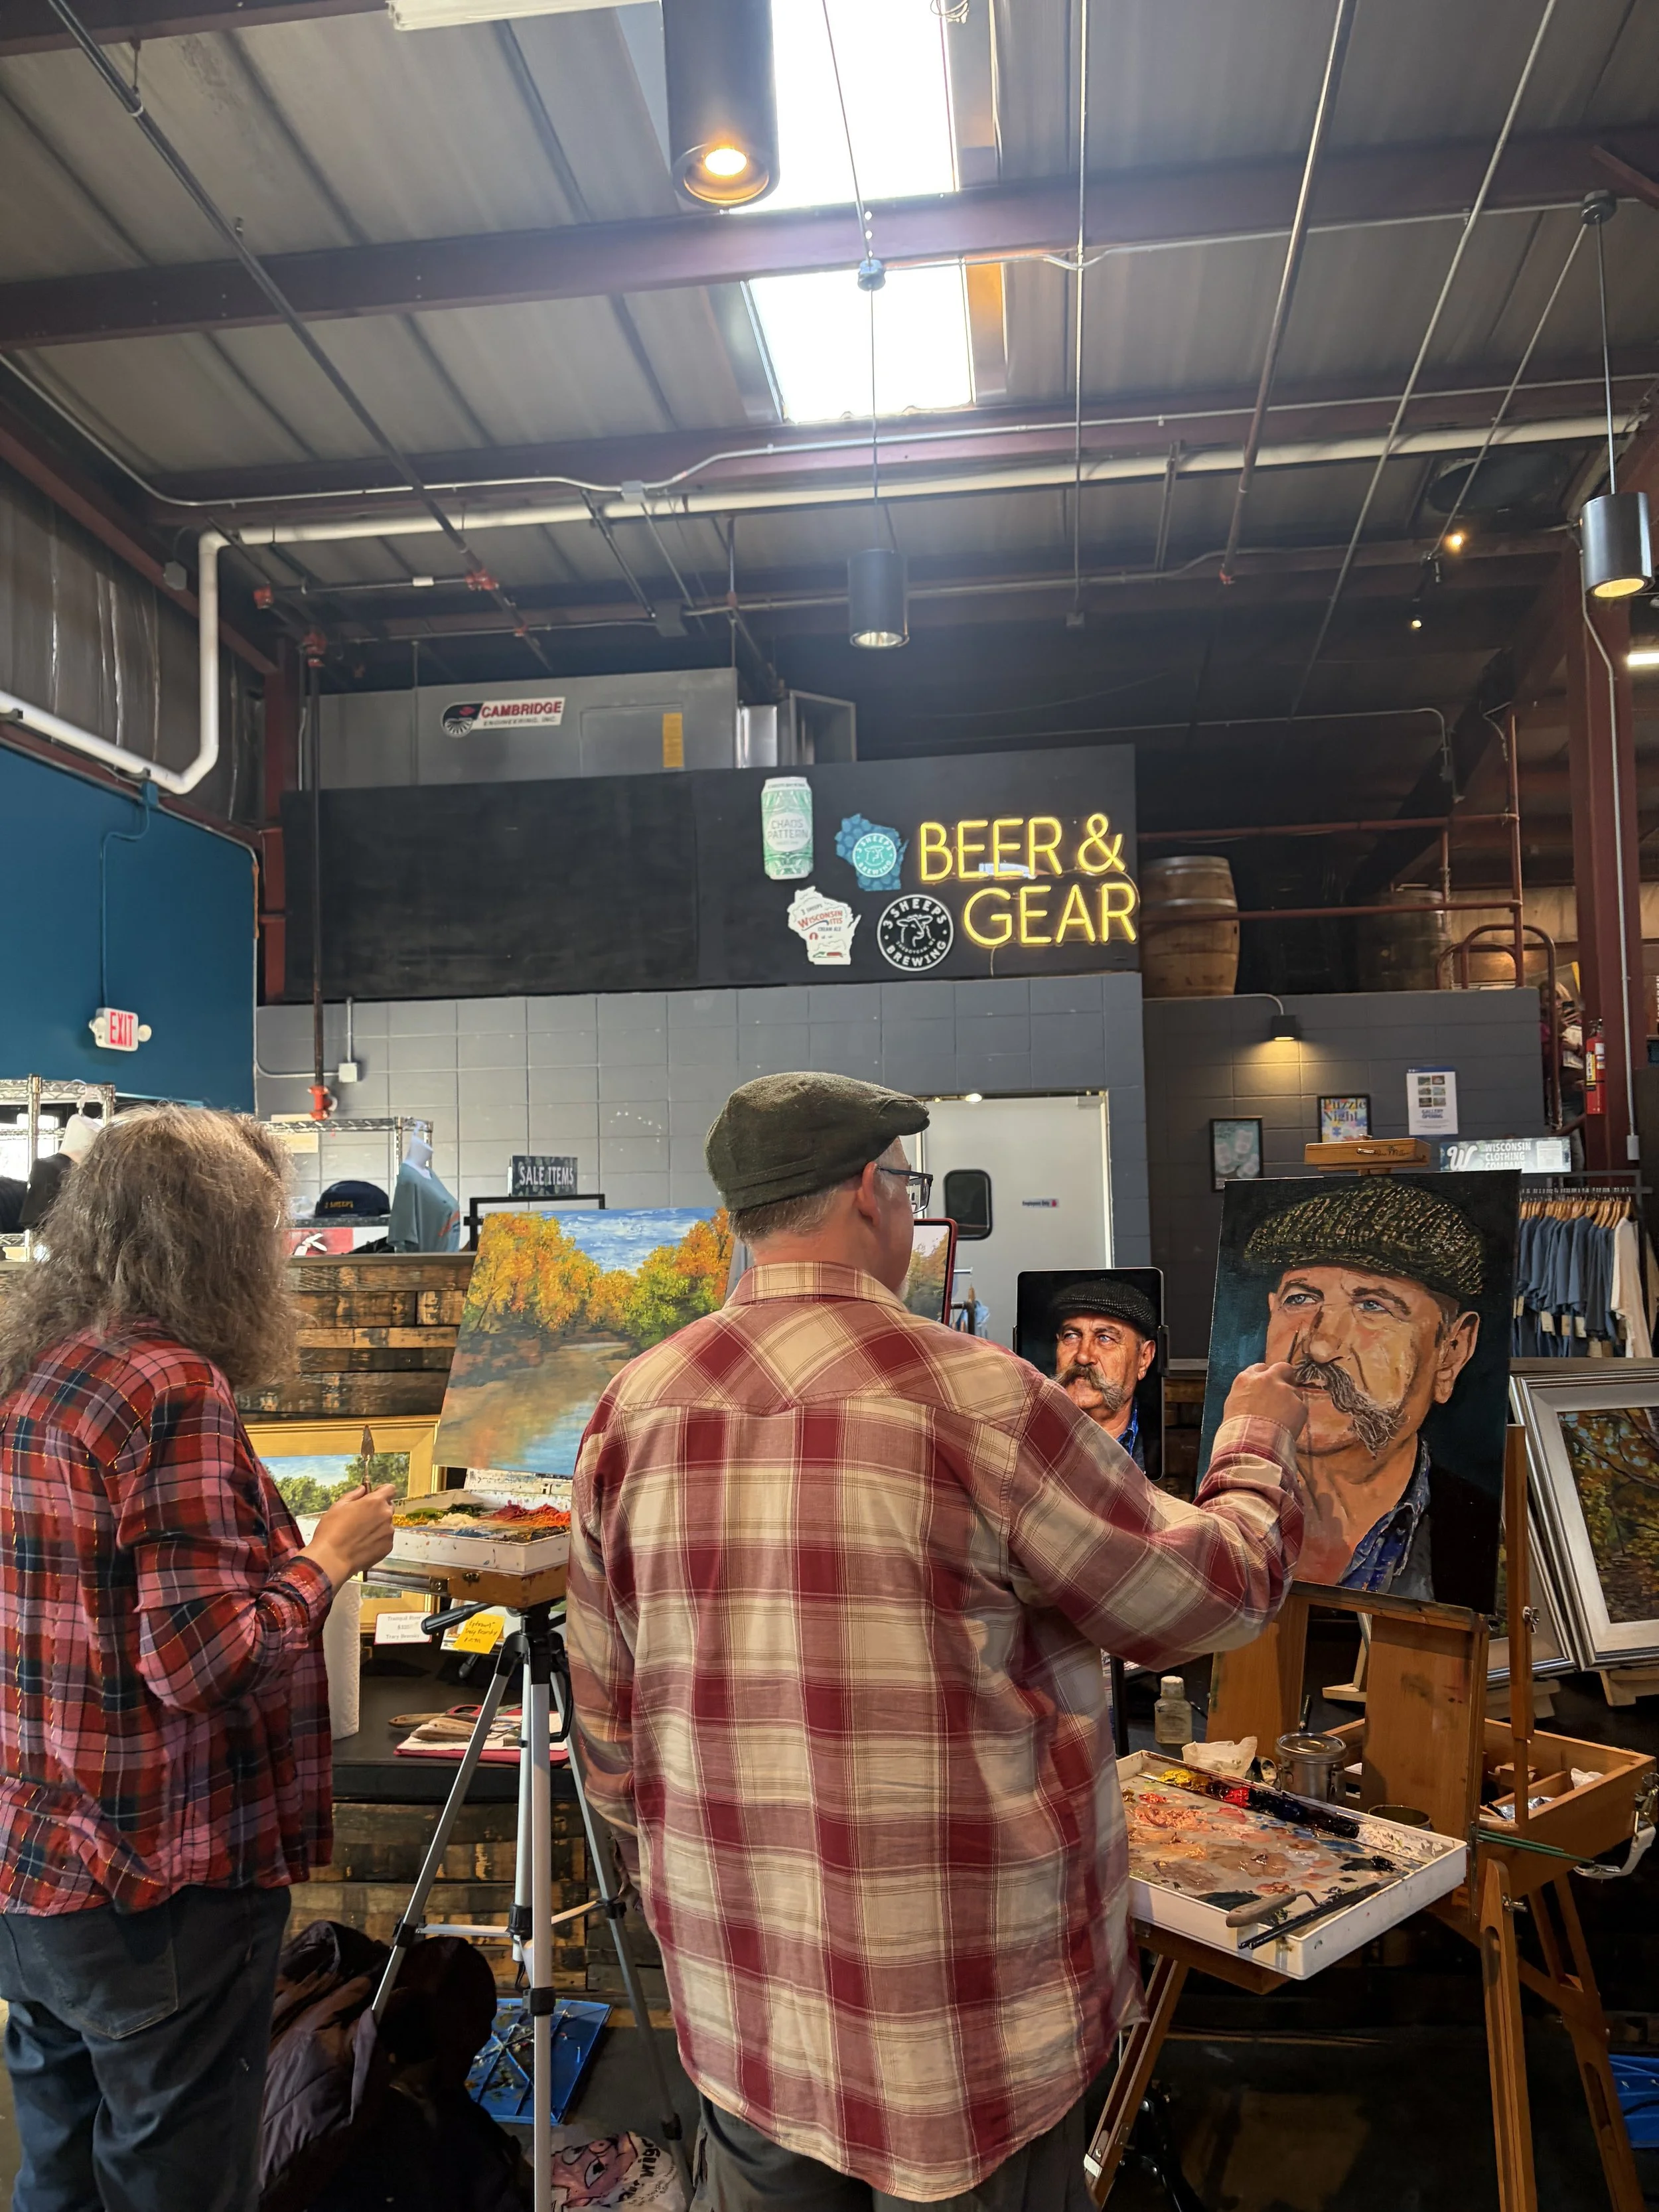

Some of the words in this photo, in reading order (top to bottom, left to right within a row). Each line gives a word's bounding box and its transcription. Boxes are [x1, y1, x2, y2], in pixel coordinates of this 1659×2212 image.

[481, 701, 563, 718] CAMBRIDGE
[771, 819, 804, 830] CHAOS
[767, 829, 809, 840] PATTERN
[920, 816, 1062, 881] BEER
[1077, 813, 1126, 873] &
[858, 859, 892, 875] BREWING
[883, 919, 894, 930] 3
[889, 898, 947, 924] SHEEPS
[964, 882, 1137, 946] GEAR
[886, 940, 947, 967] BREWING
[110, 1011, 134, 1047] EXIT
[1324, 1098, 1366, 1112] Puzzle
[1323, 1110, 1358, 1123] Night
[1485, 1142, 1532, 1153] WISCONSIN
[1485, 1151, 1526, 1161] CLOTHING
[520, 1165, 545, 1186] SALE
[548, 1166, 574, 1186] ITEMS
